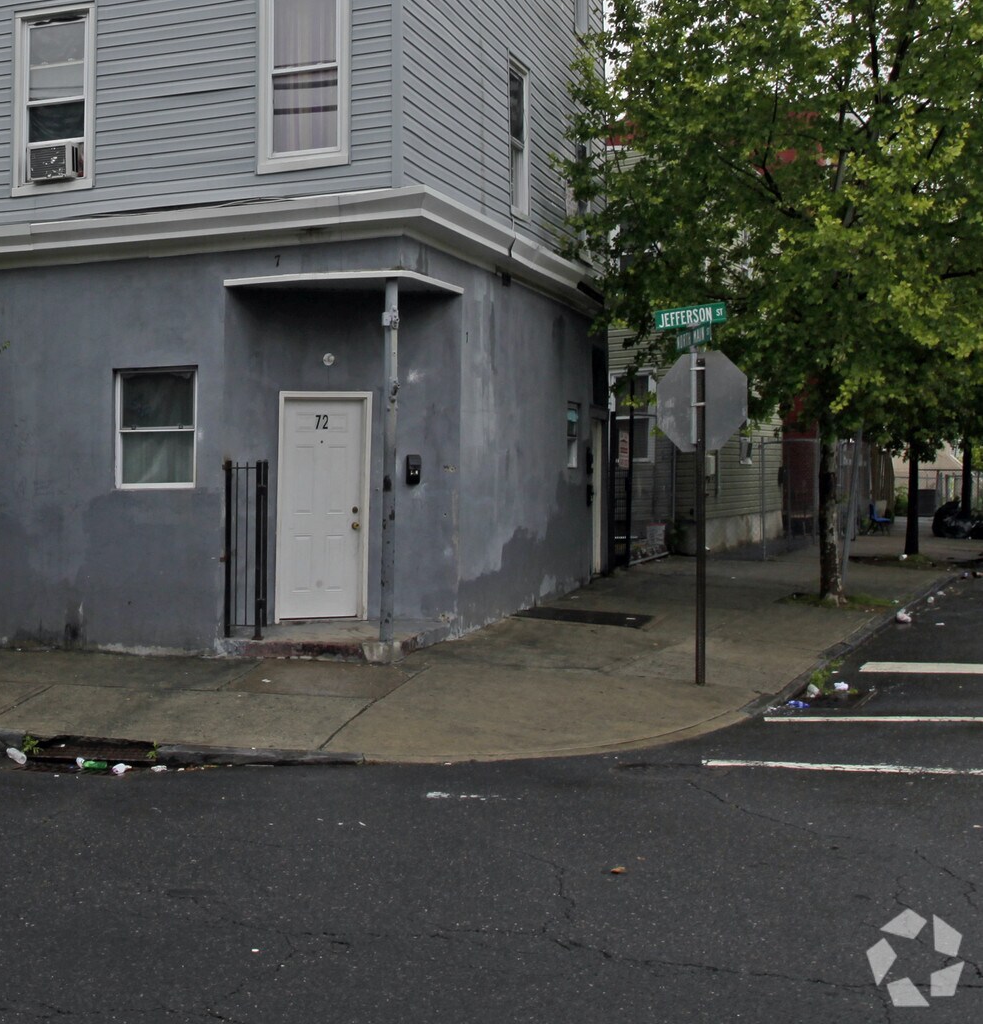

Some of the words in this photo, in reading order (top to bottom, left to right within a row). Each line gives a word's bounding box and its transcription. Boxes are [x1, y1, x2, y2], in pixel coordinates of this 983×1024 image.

[659, 307, 713, 328] JEFFERSON
[715, 308, 723, 317] ST
[315, 414, 329, 430] 72
